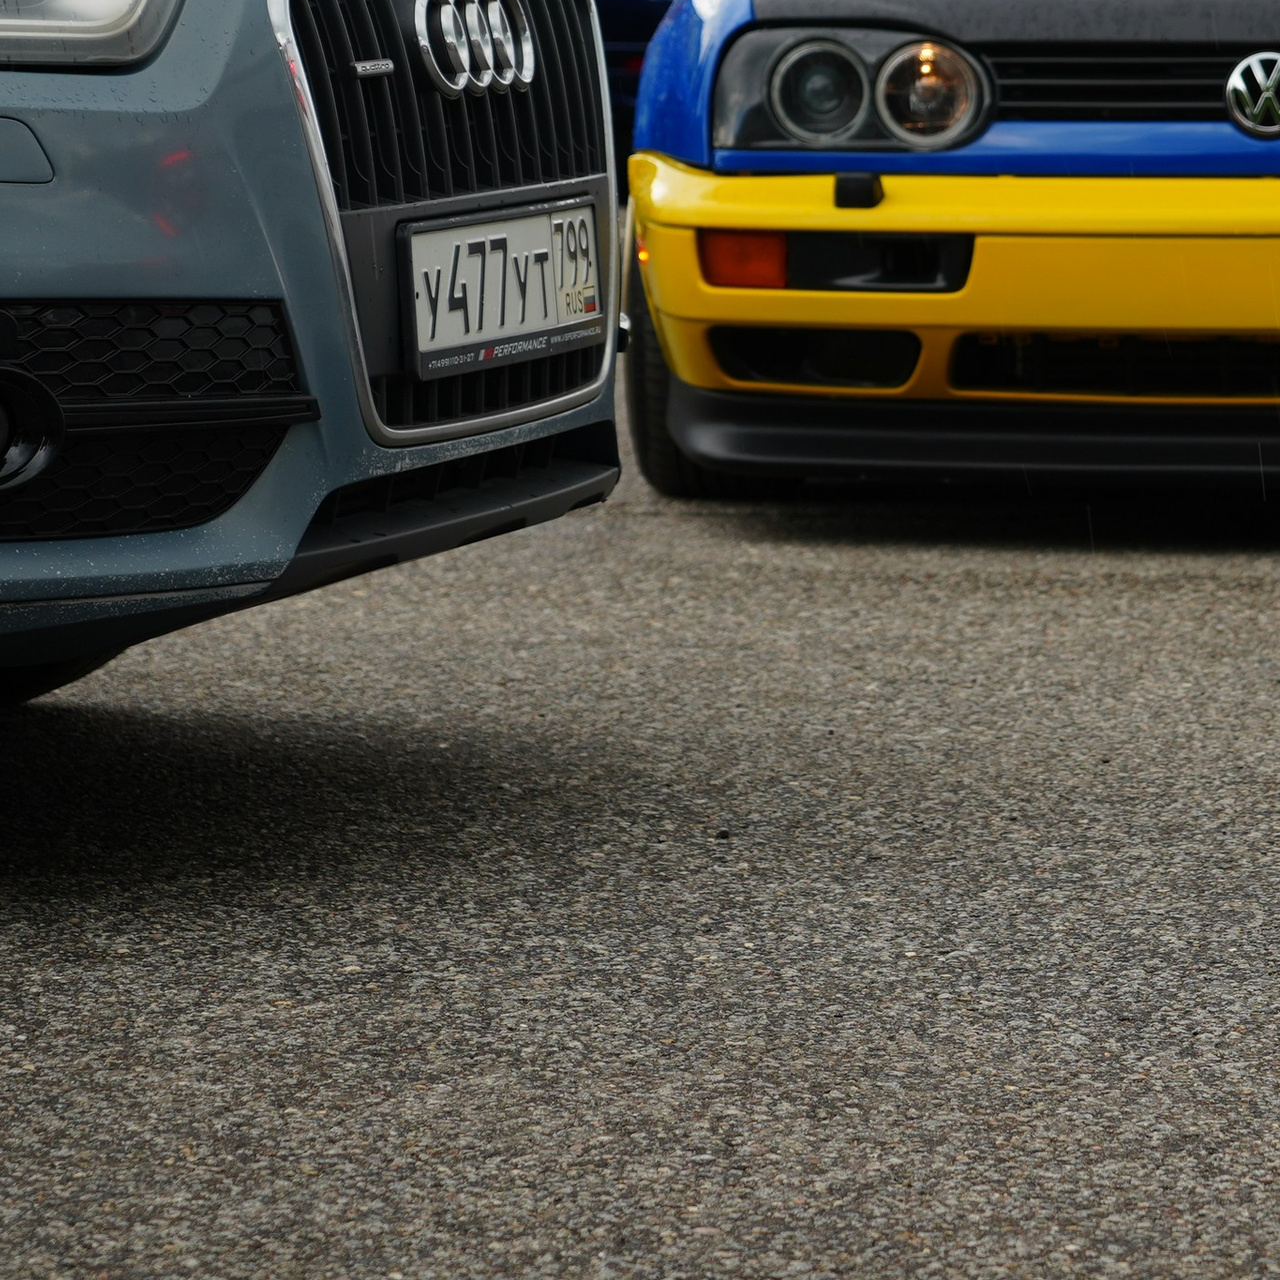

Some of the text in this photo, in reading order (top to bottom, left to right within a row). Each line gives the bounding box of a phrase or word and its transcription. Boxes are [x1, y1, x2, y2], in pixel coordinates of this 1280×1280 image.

[361, 63, 389, 72] quattro
[552, 216, 590, 291] 799
[566, 290, 584, 317] RUS
[493, 336, 548, 358] PERFORMANCE
